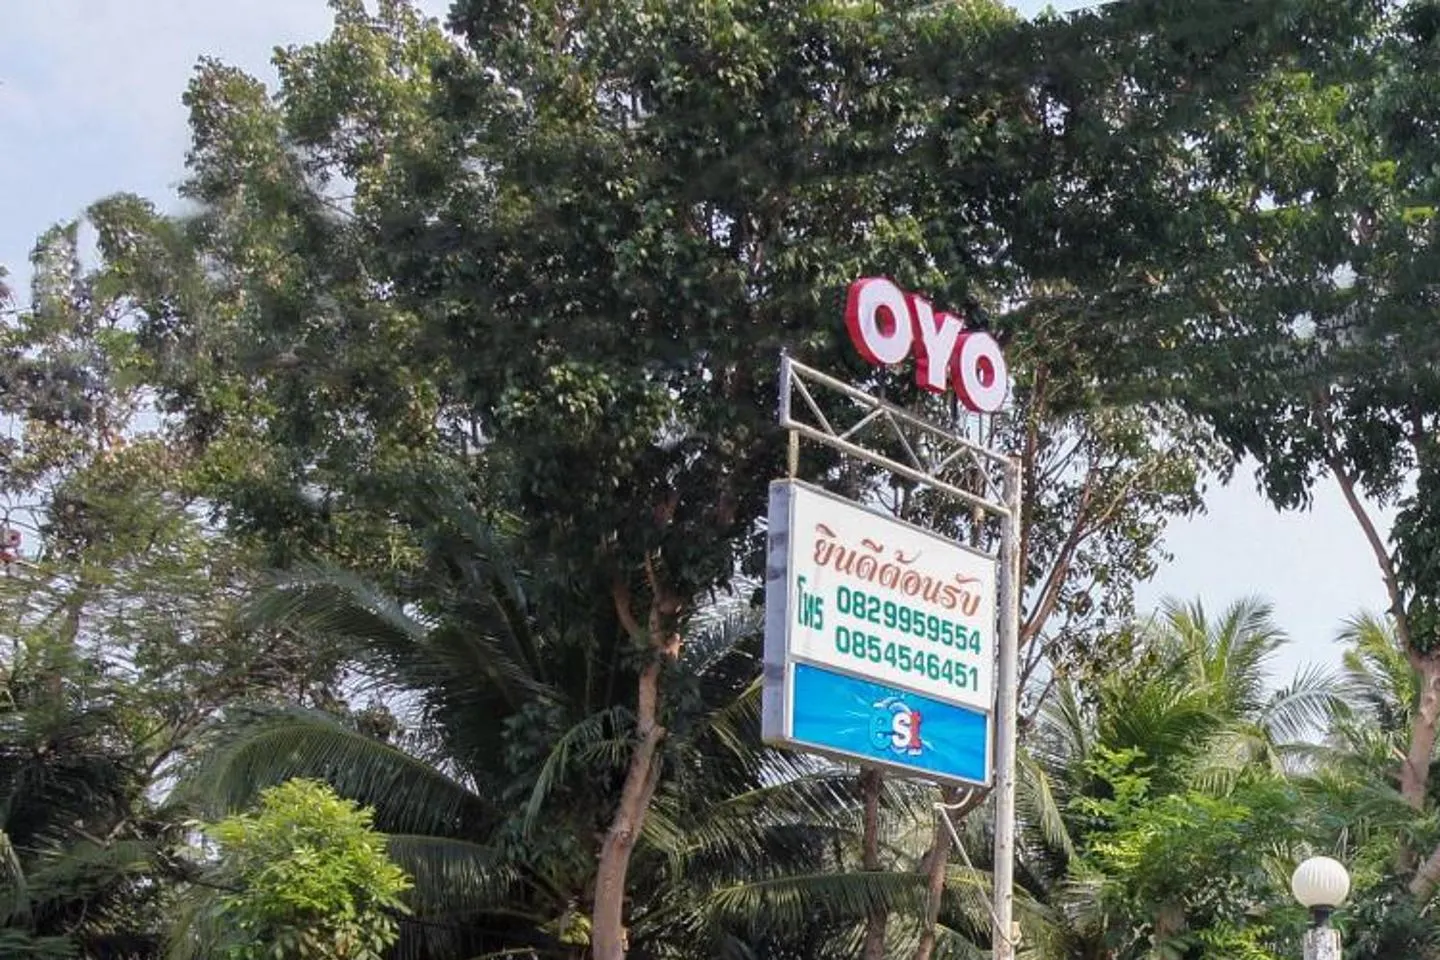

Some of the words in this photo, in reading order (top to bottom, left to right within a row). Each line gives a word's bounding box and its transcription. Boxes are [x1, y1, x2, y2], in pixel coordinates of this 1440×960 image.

[846, 276, 1008, 413] OYO
[813, 523, 982, 617] ยินดีต้อนรับ
[797, 575, 824, 631] โทร
[836, 585, 982, 655] 0829959554
[835, 625, 979, 692] 0854546451
